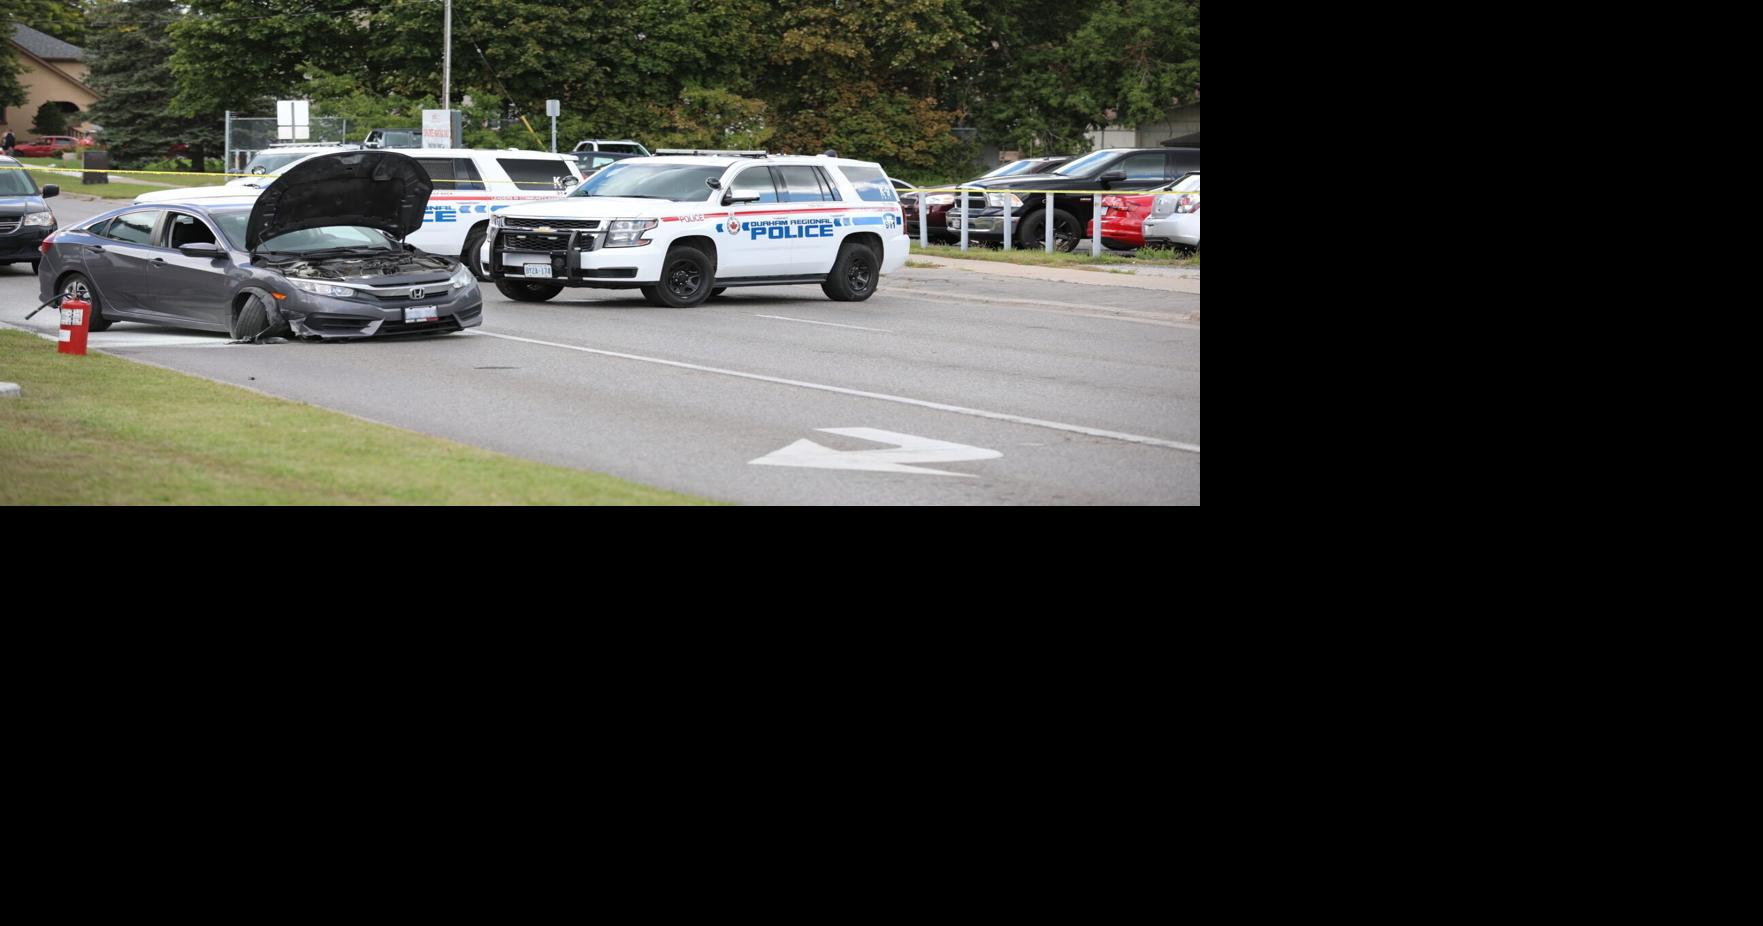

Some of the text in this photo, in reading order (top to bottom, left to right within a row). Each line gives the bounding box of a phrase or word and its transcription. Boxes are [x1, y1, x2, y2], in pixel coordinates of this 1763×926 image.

[680, 214, 705, 222] POLICE
[750, 219, 788, 227] DURHAM
[751, 224, 834, 241] POLICE
